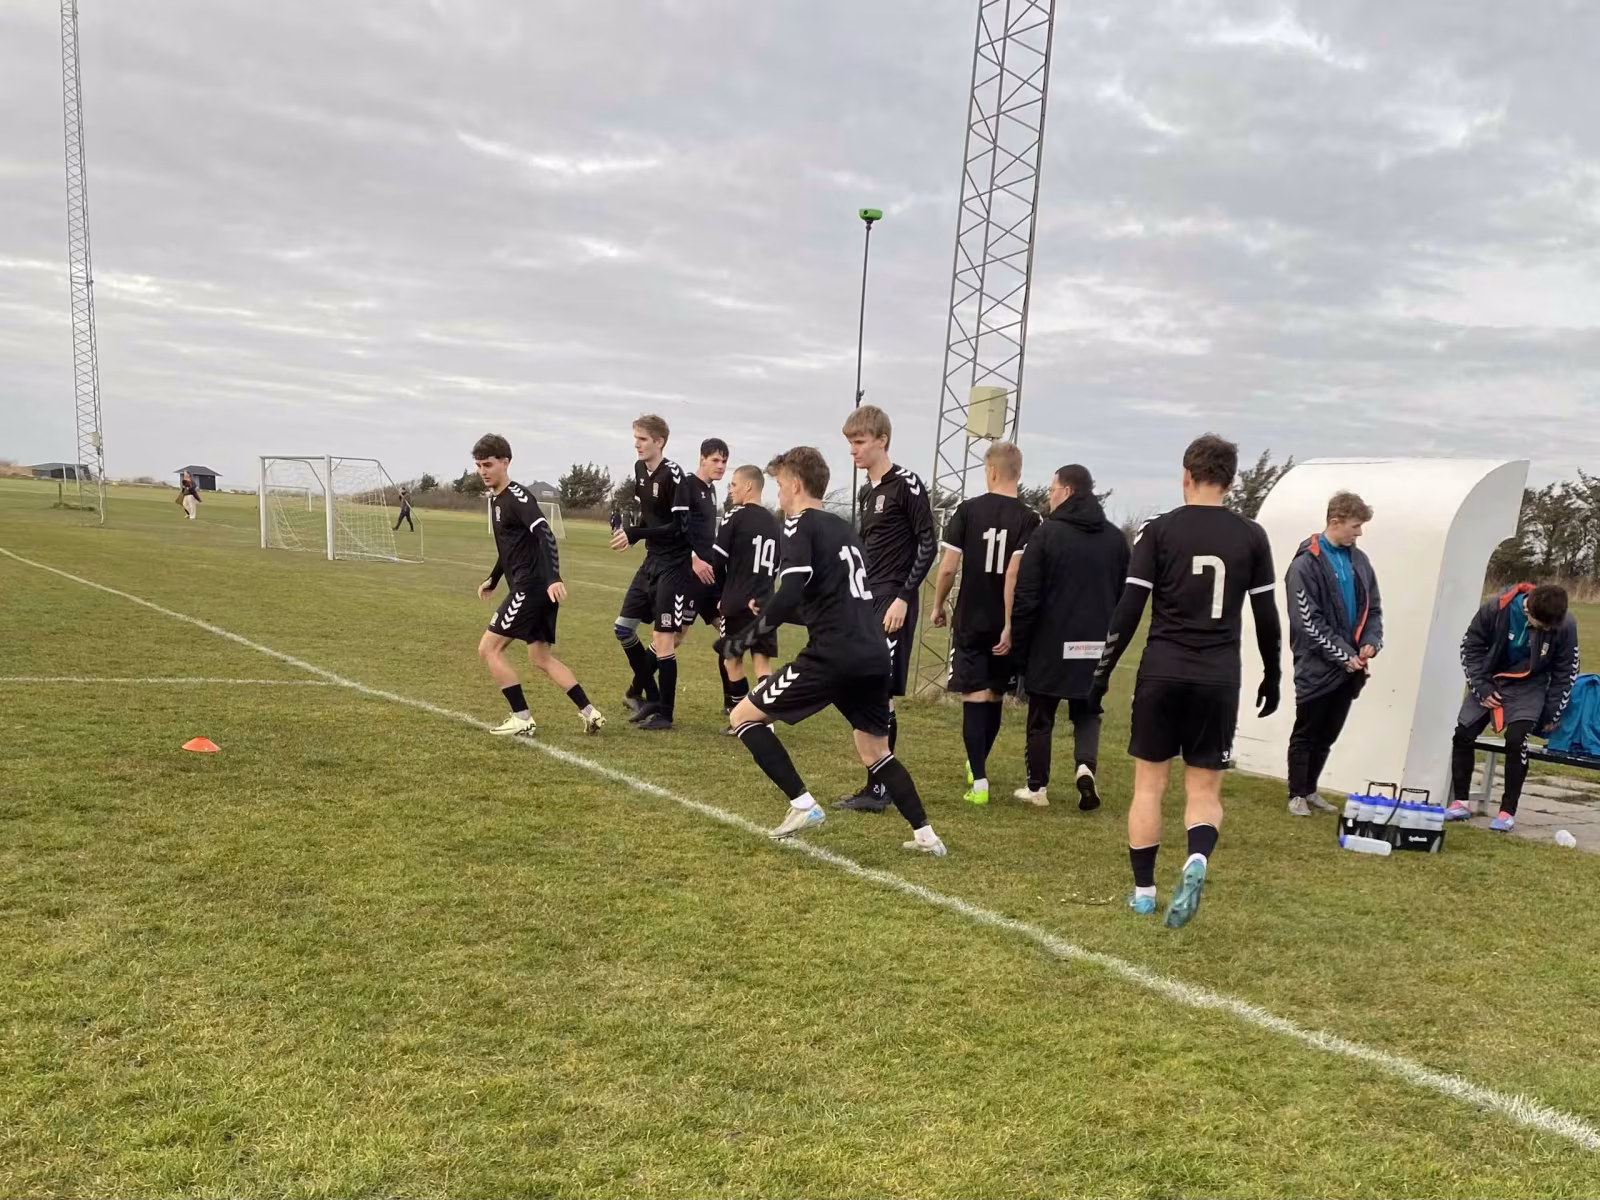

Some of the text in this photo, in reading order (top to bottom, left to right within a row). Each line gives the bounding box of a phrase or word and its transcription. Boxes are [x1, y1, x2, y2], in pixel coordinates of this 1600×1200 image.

[752, 535, 776, 577] 14
[838, 545, 873, 600] 12
[983, 527, 1008, 574] 11
[1192, 555, 1226, 619] 7
